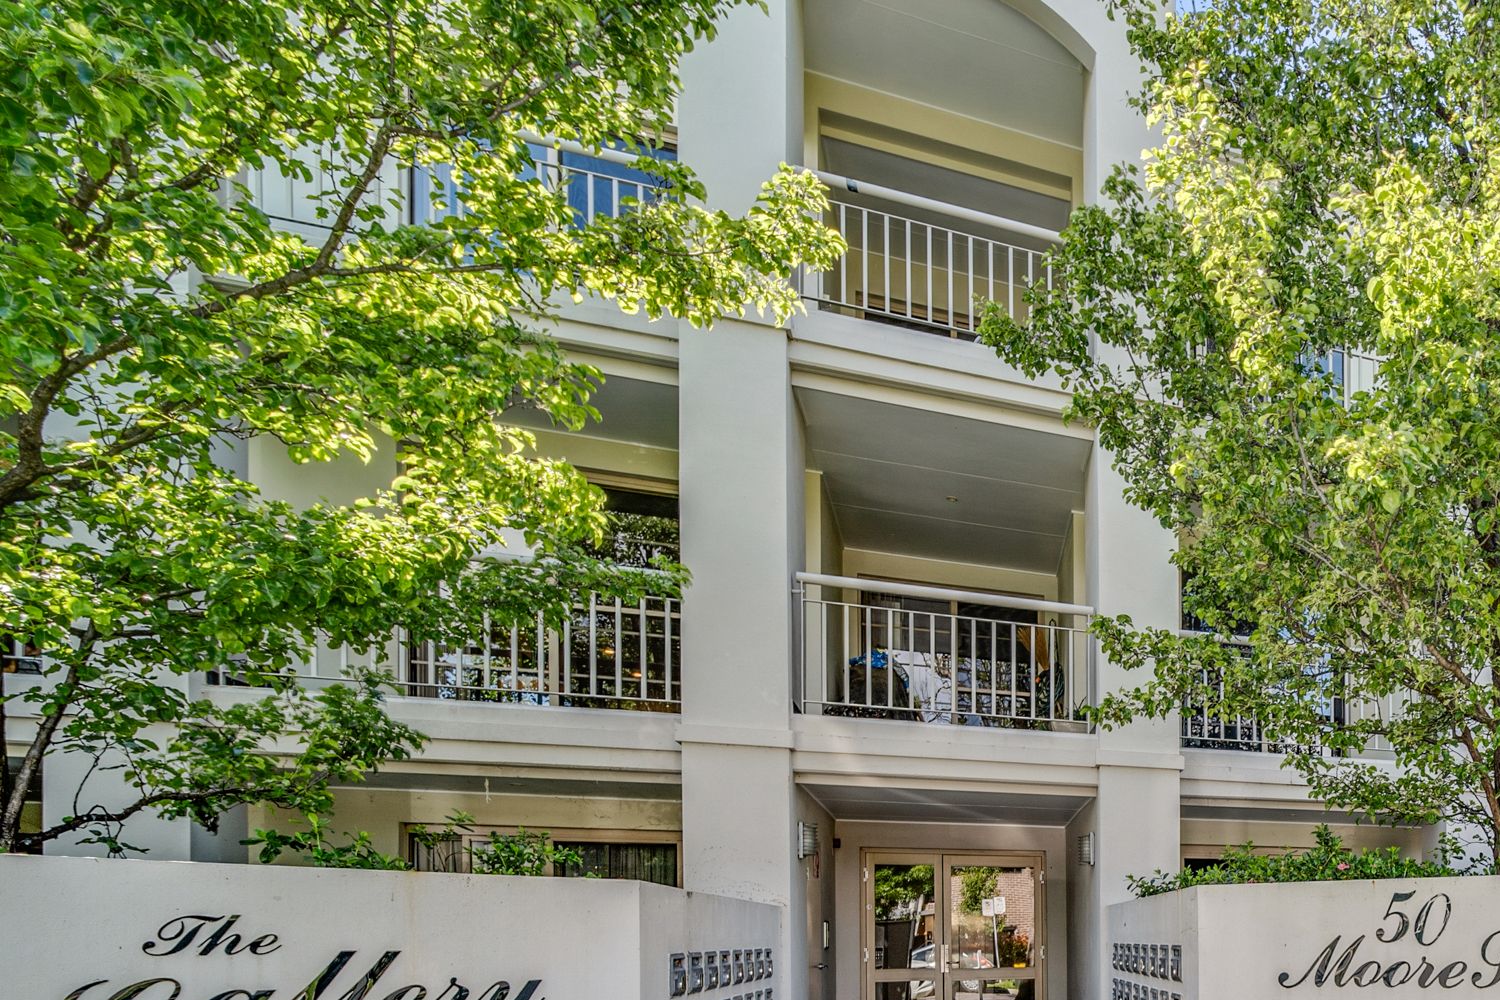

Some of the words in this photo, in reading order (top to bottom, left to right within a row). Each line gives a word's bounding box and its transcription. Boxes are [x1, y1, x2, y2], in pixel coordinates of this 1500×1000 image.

[141, 914, 283, 956] The
[1376, 889, 1452, 947] 50
[1277, 934, 1468, 988] Moore
